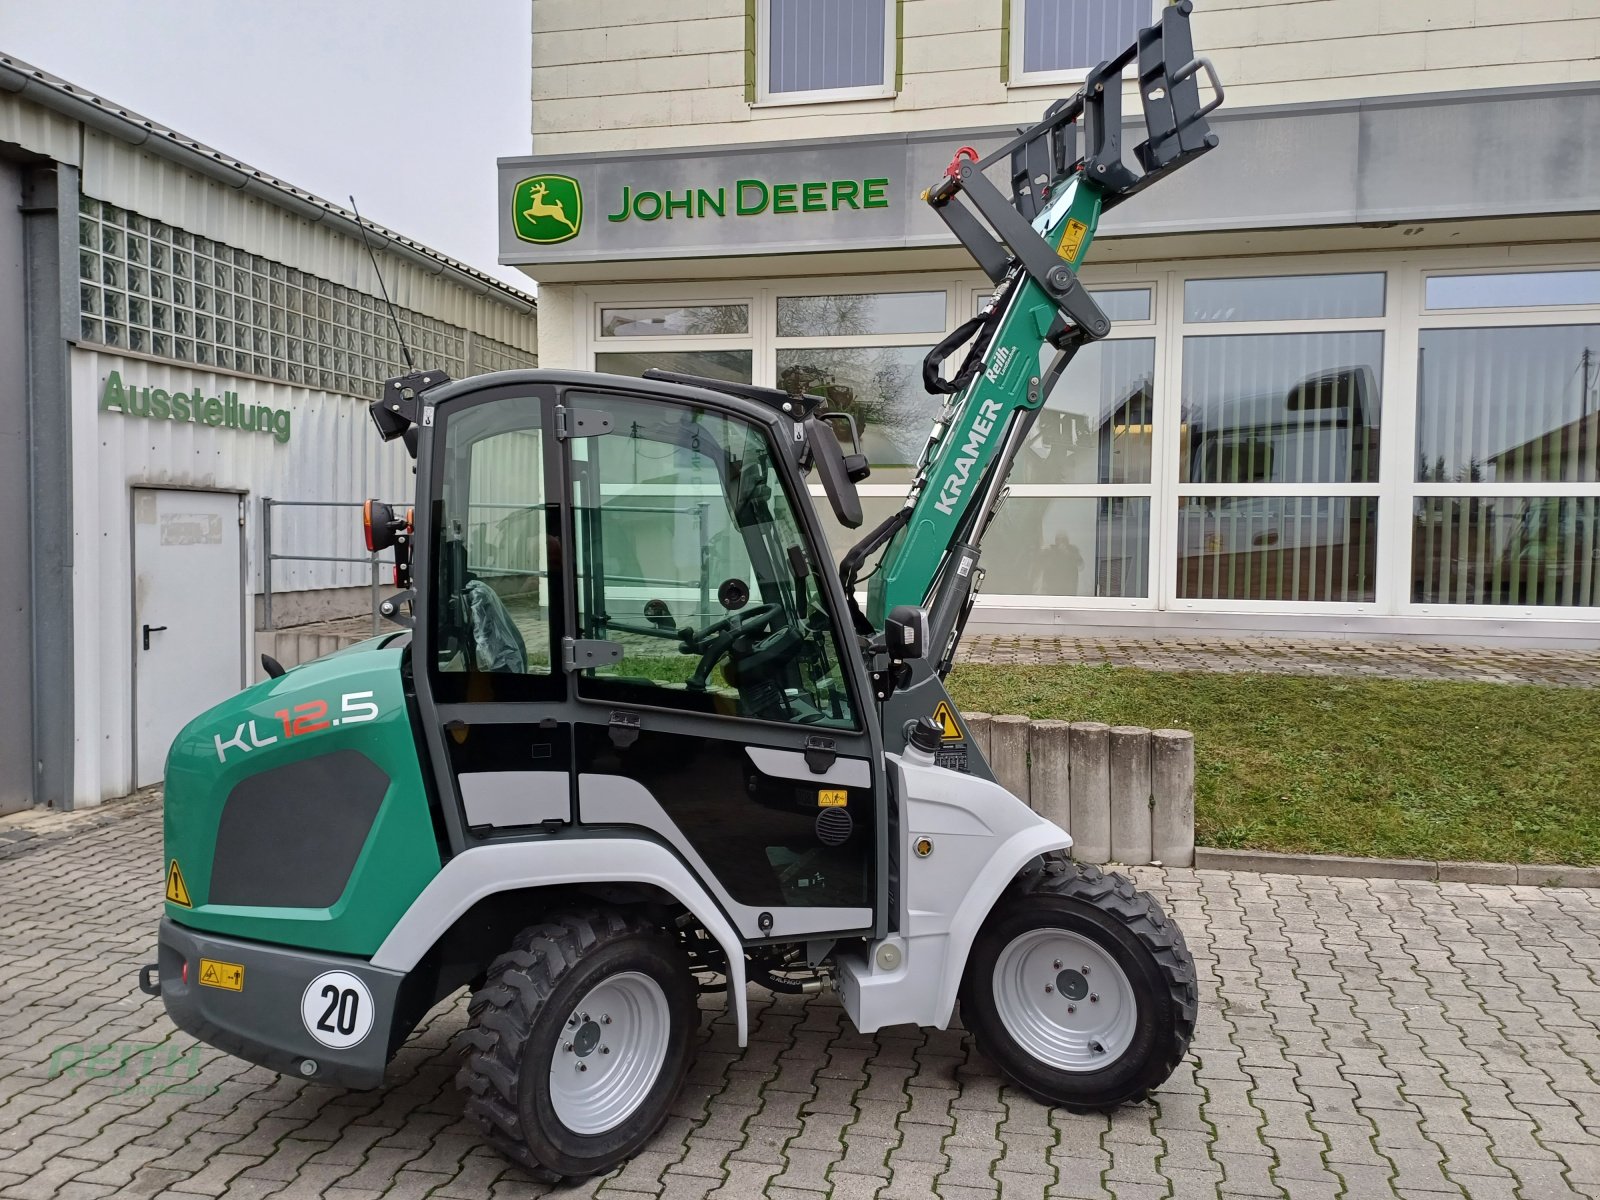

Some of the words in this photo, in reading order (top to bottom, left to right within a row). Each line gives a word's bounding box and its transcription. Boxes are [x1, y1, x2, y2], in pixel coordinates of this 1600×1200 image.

[608, 186, 726, 222] JOHN
[736, 178, 889, 216] DEERE
[985, 347, 1010, 384] Reith
[100, 370, 291, 443] Ausstellung
[933, 398, 1004, 516] KRAMER
[316, 984, 359, 1036] 20
